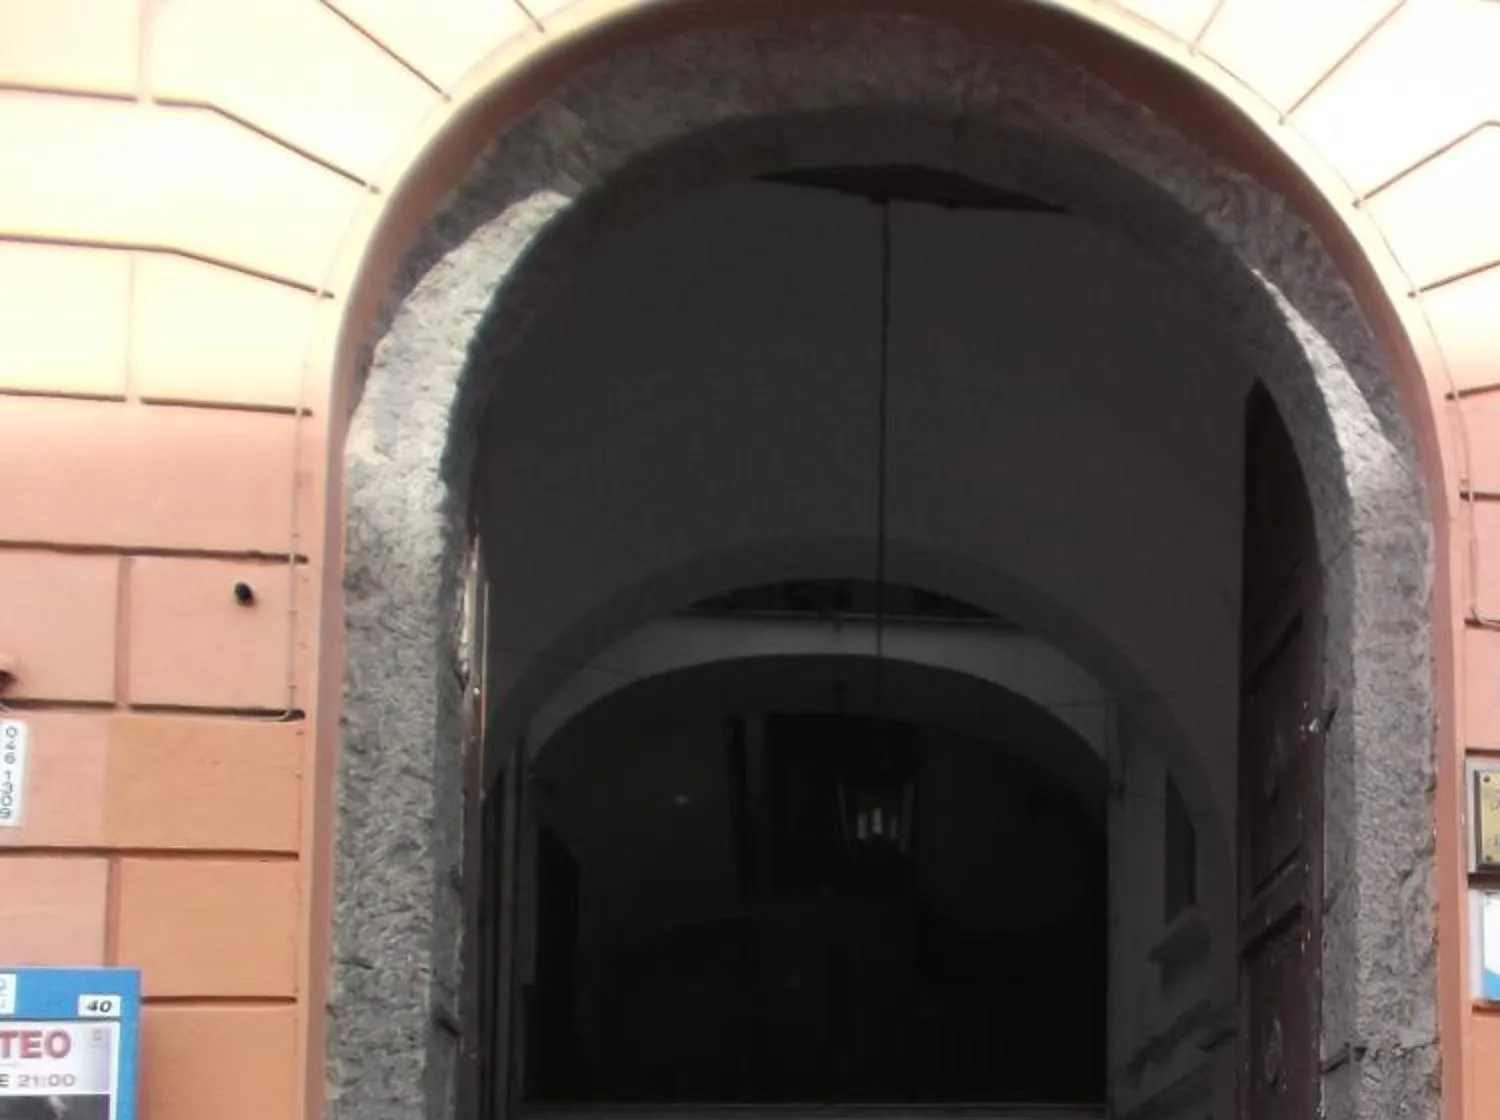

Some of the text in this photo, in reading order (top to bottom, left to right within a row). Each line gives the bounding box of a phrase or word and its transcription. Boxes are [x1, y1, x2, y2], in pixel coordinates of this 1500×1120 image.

[86, 999, 113, 1013] 40
[0, 1029, 72, 1060] TEO
[17, 1073, 76, 1088] 21:00
